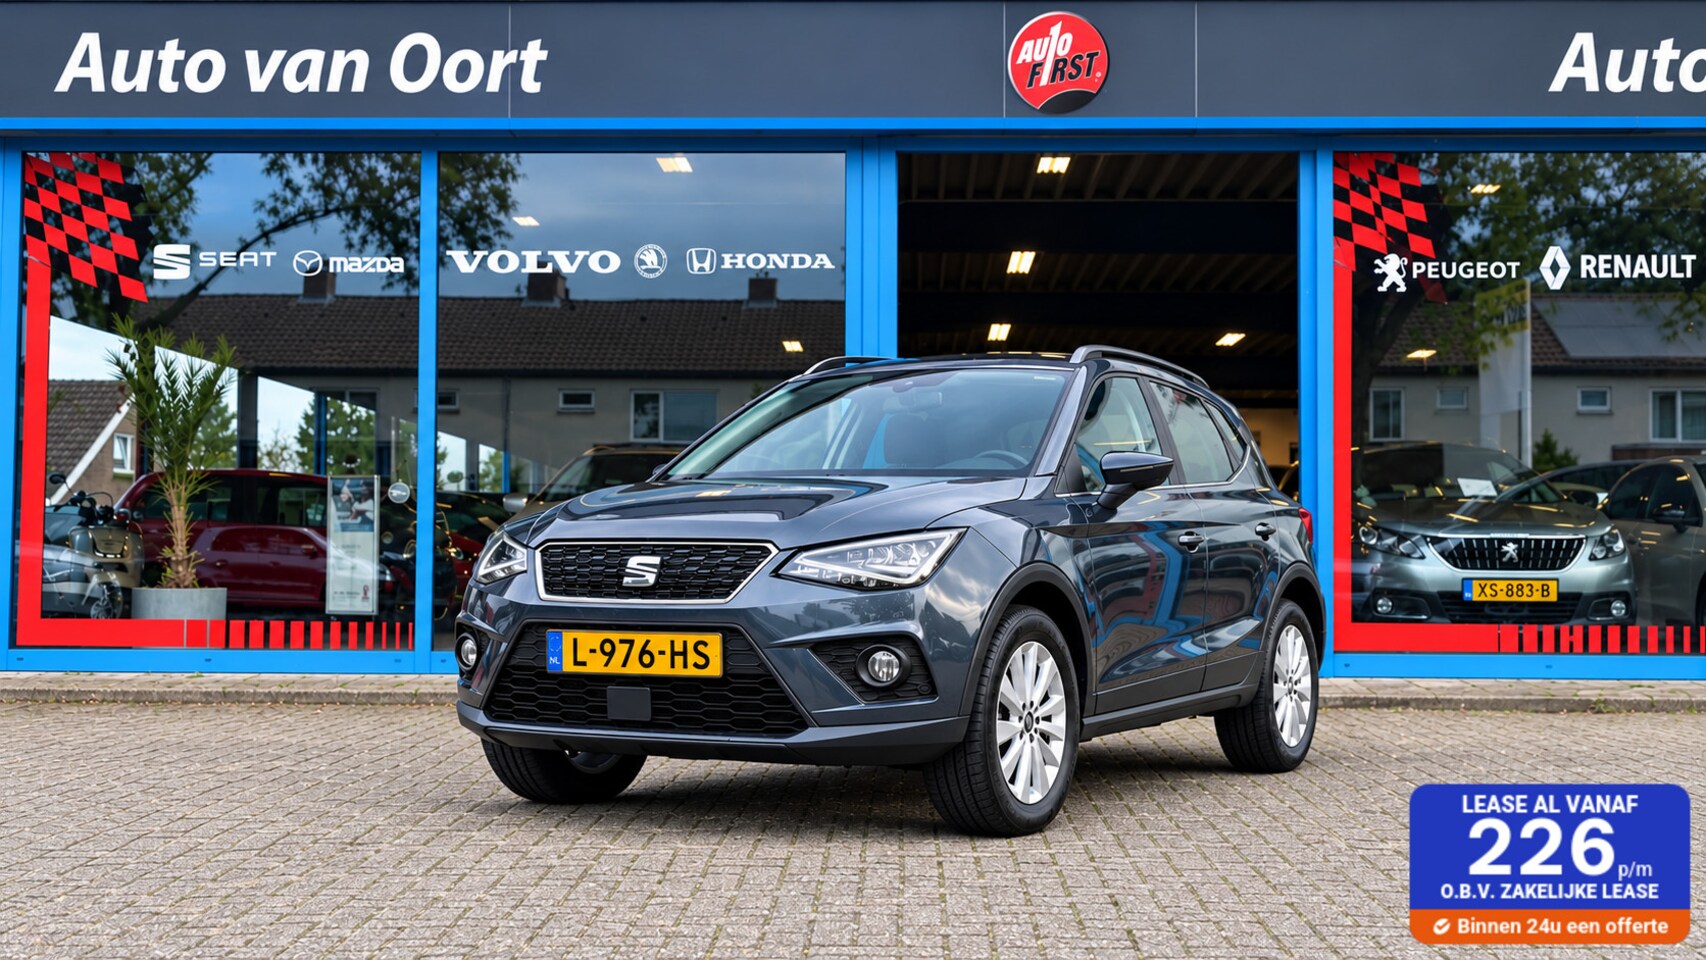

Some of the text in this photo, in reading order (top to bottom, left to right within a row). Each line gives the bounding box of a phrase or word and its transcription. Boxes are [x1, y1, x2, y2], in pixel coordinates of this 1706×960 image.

[54, 32, 548, 93] Auto van Oort
[1548, 32, 1706, 93] Auto
[199, 251, 277, 267] SEAT
[446, 250, 621, 274] VOLVO
[721, 252, 835, 270] HONDA
[1579, 254, 1697, 279] RENAULT
[1411, 261, 1520, 279] PEUGEOT
[1477, 583, 1550, 598] XS-883-B
[549, 656, 561, 665] NL
[572, 637, 711, 670] L-976-HS
